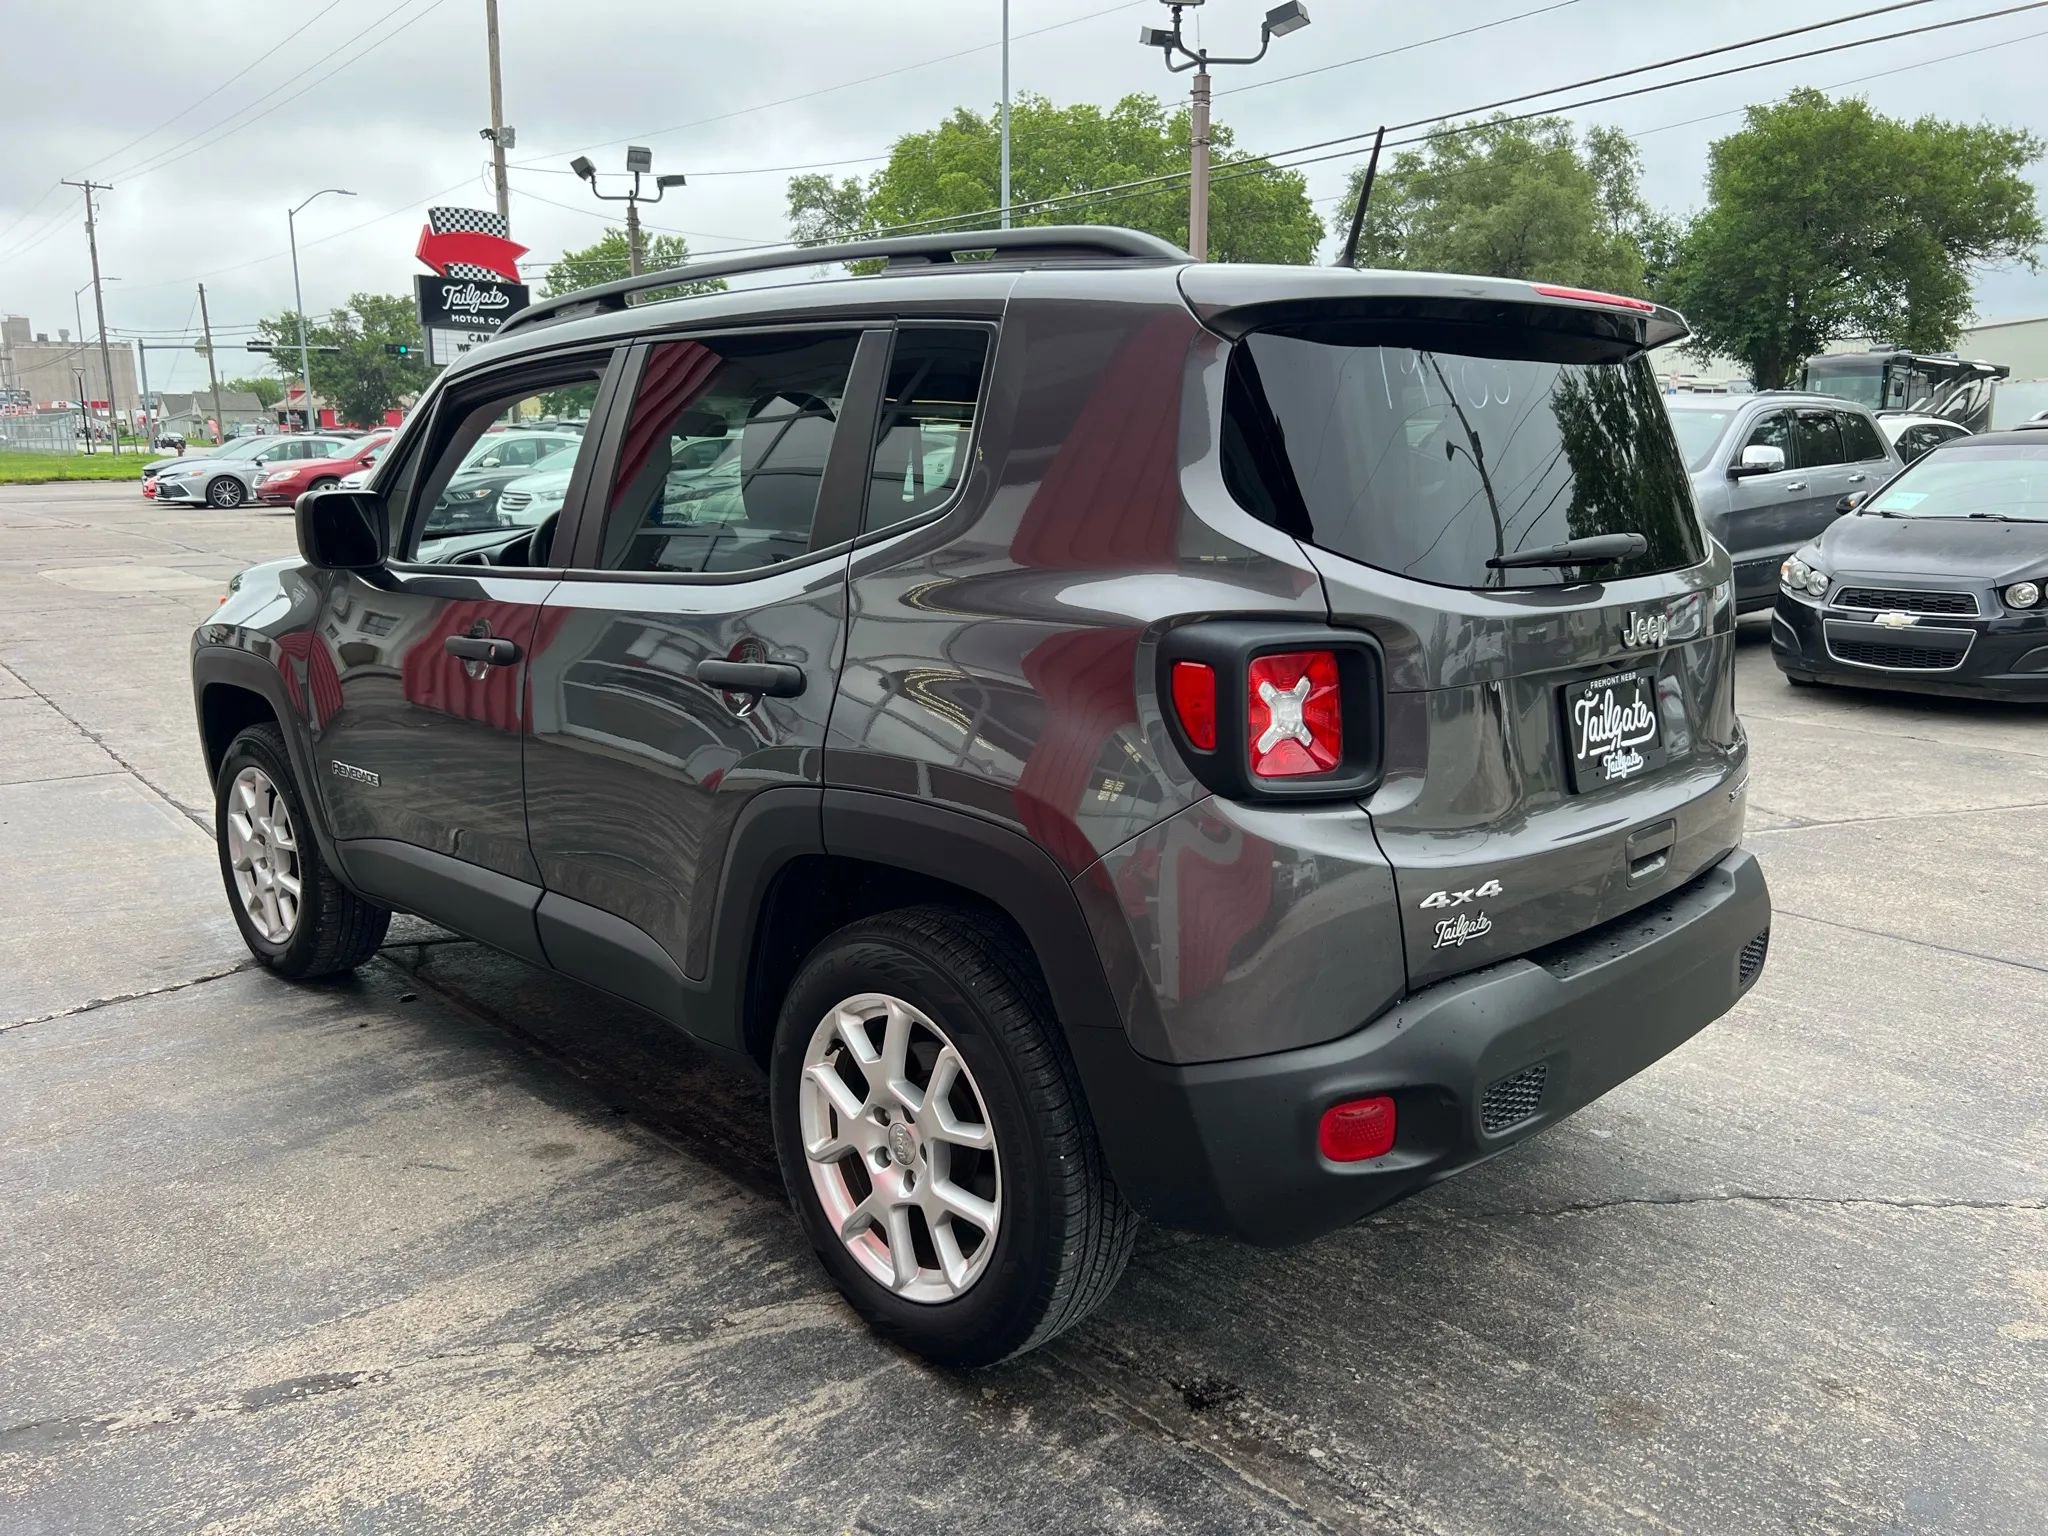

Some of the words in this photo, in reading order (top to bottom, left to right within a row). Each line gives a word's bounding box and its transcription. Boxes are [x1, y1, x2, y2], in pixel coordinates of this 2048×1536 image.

[442, 283, 510, 313] Tailgate
[451, 314, 485, 324] MOTOR
[1623, 611, 1668, 647] Jeep
[1590, 675, 1620, 690] FREMONT
[1574, 688, 1656, 760] Tailgate
[1602, 748, 1644, 780] Tailgate
[1419, 879, 1503, 909] 4x4
[1432, 911, 1492, 949] Tailgate
